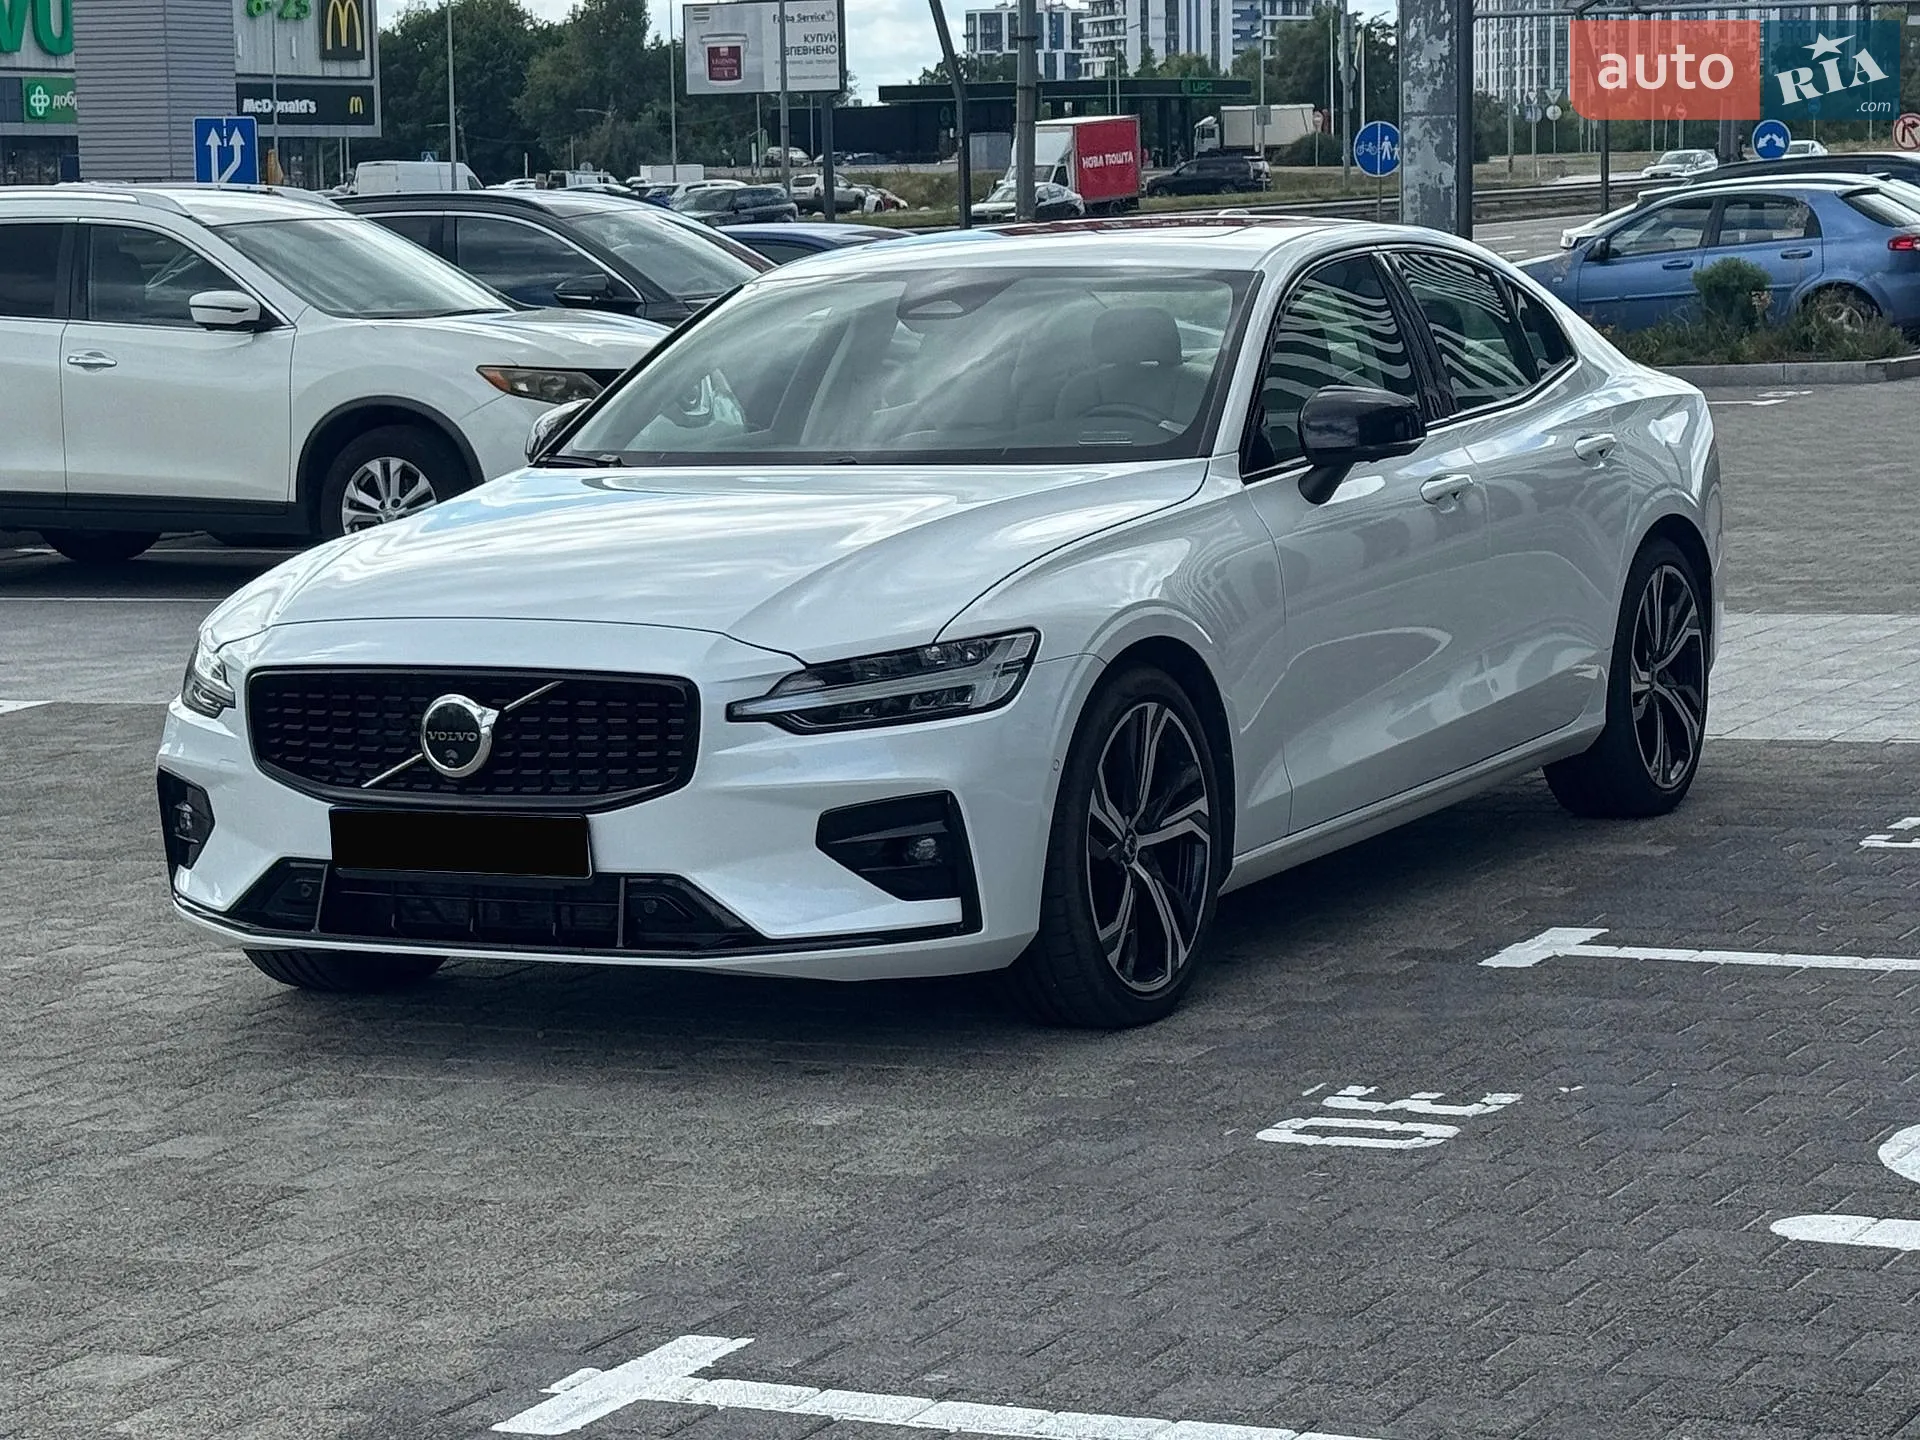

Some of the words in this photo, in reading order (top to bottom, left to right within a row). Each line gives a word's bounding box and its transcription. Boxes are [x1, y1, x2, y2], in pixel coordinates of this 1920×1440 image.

[797, 12, 825, 22] Service
[804, 31, 837, 43] КУПУЙ
[1082, 155, 1104, 169] НОВА
[1105, 151, 1134, 166] ПОШТА
[428, 731, 478, 742] VOLVO
